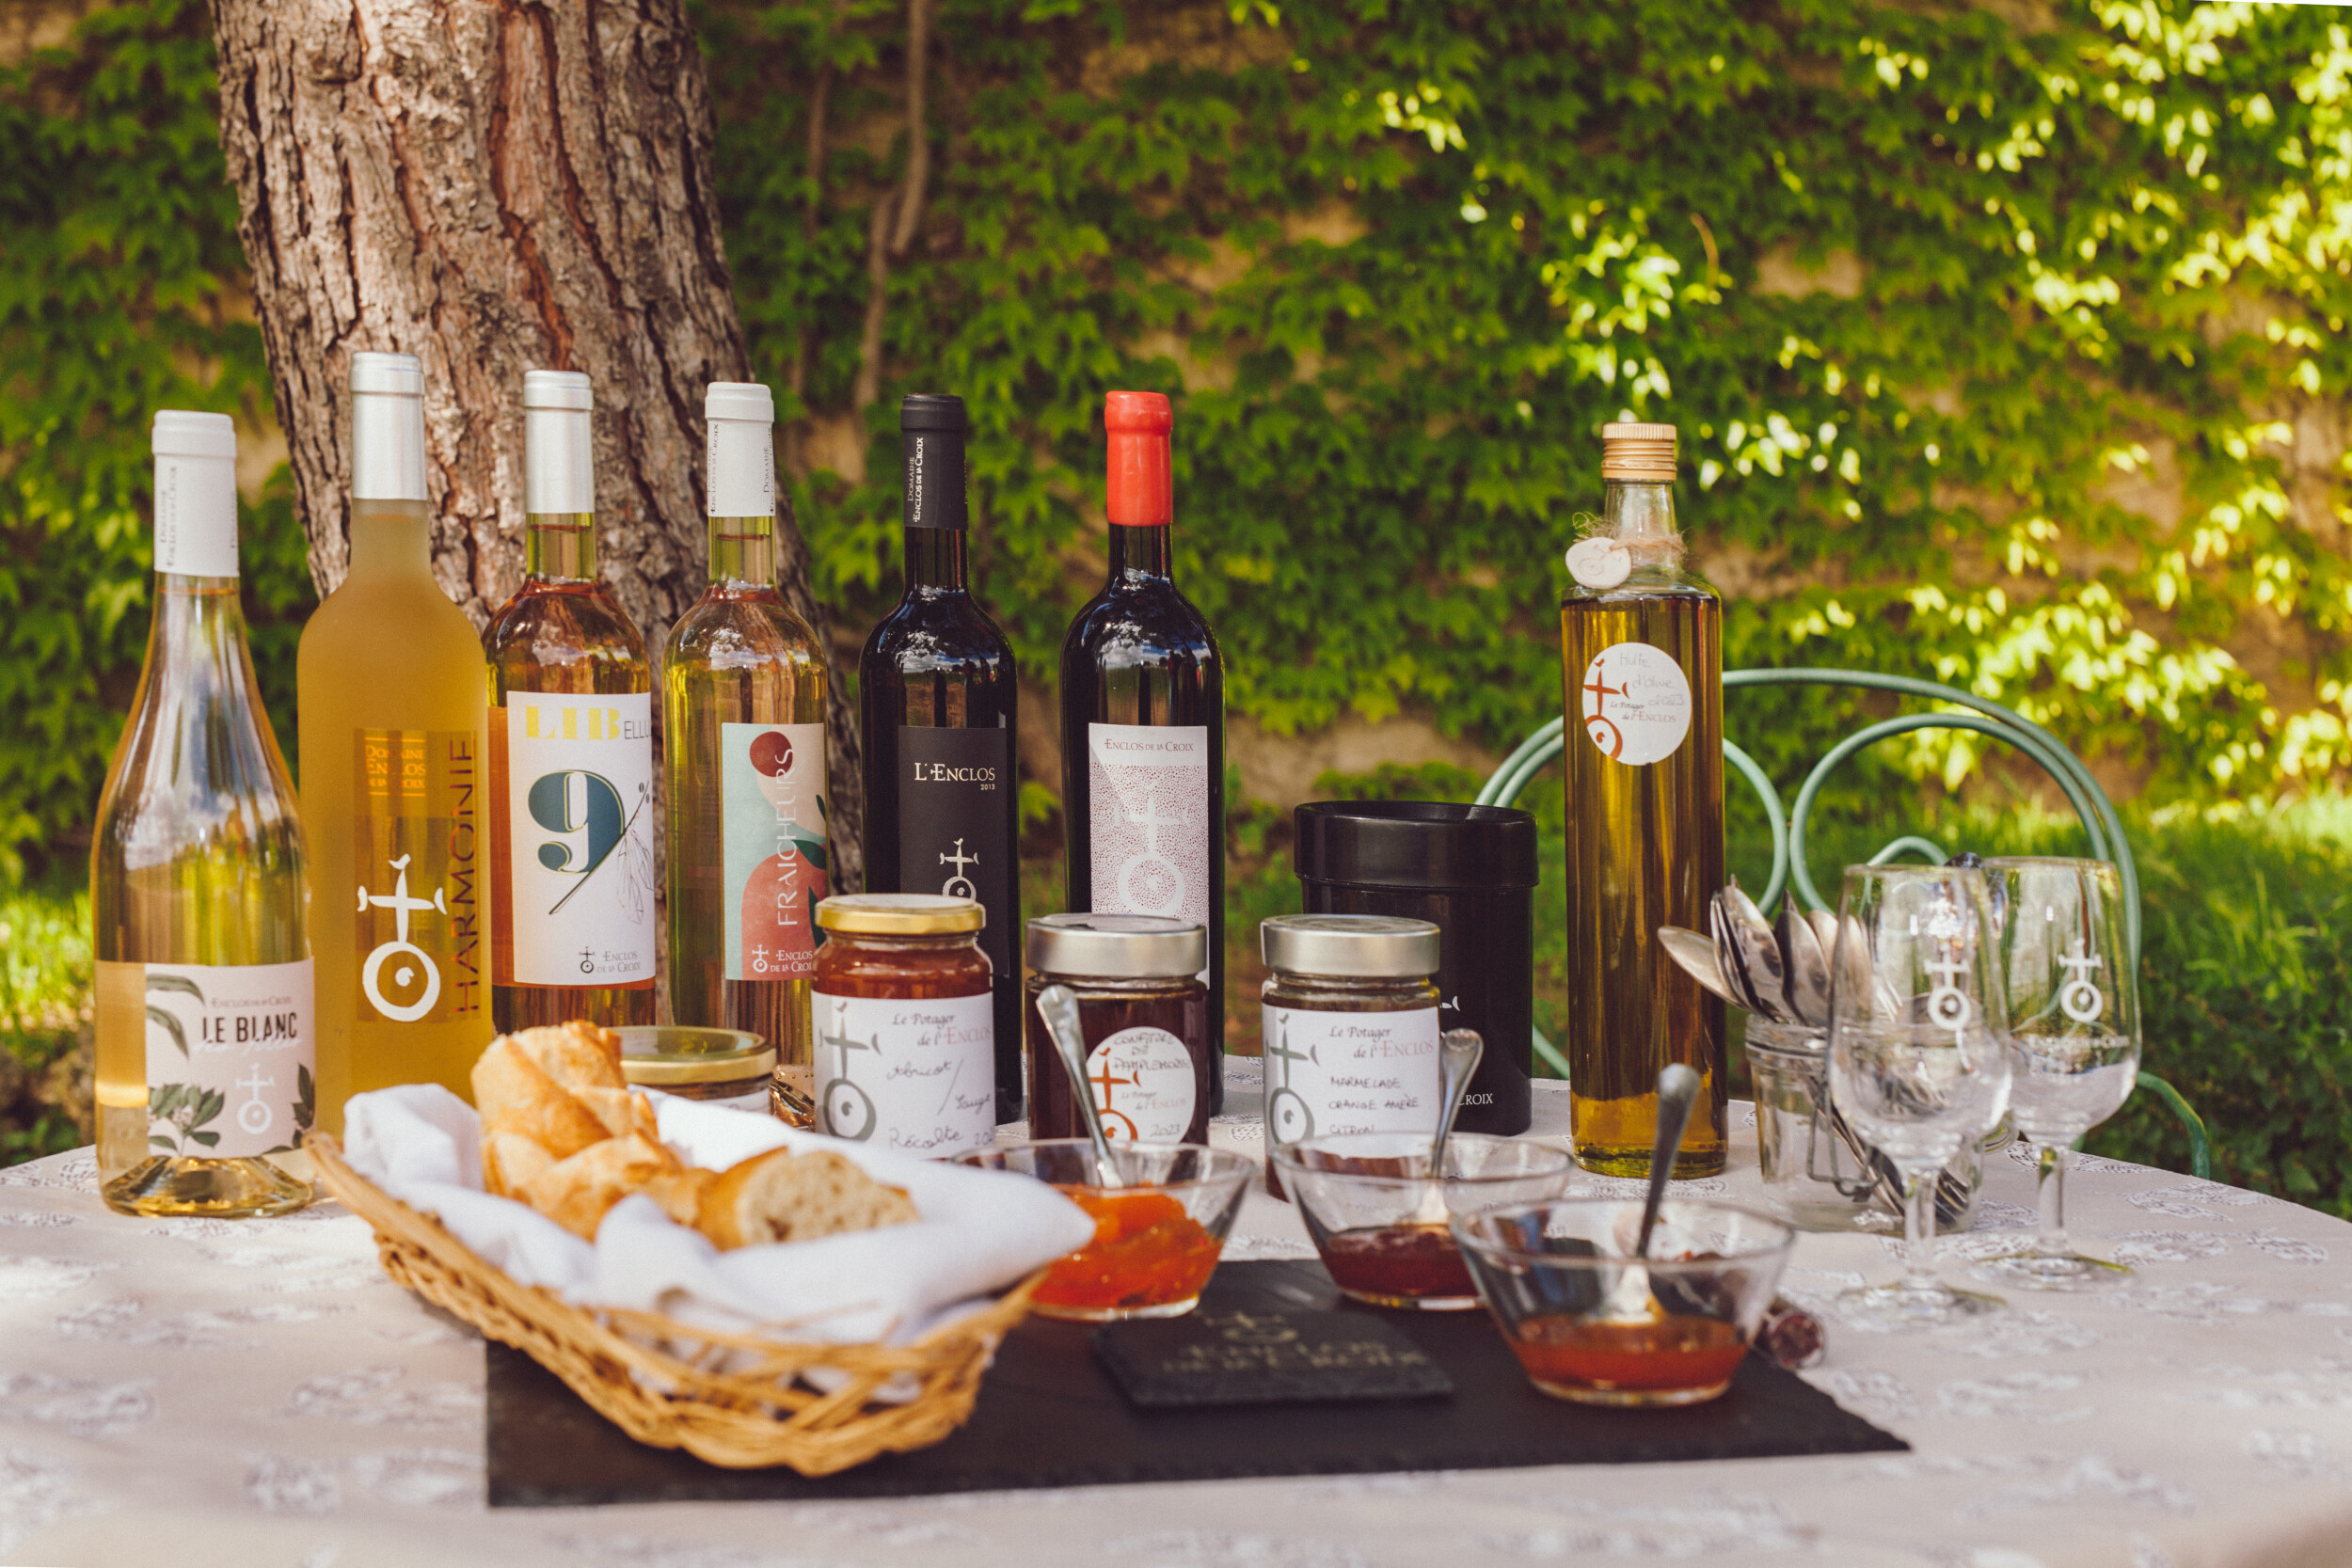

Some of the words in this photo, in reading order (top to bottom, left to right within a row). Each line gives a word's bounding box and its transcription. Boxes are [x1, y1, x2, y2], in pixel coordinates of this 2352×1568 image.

[914, 437, 923, 467] CROIX
[915, 474, 922, 484] DE
[913, 484, 922, 523] ENCLOS
[1104, 738, 1144, 752] ENCLOS
[1165, 741, 1194, 752] CROIX
[914, 762, 996, 782] L'ENCLOS
[449, 739, 479, 1013] HARMONIE
[603, 950, 638, 961] ENCLOS
[776, 949, 814, 961] ENCLOS
[617, 961, 642, 973] CROIX
[770, 964, 781, 973] DE
[782, 963, 789, 973] LA
[791, 960, 812, 973] CROI
[202, 1016, 226, 1044] LE
[235, 1011, 298, 1043] BLANC
[892, 1013, 908, 1026] Le
[911, 1012, 956, 1031] Potager
[916, 1032, 931, 1047] de
[1329, 1025, 1343, 1037] Le
[1346, 1025, 1392, 1043] Potager
[1352, 1043, 1367, 1058] de
[1329, 1076, 1402, 1089] MARMELADE
[1327, 1099, 1377, 1111] ORANGE
[1384, 1093, 1421, 1111] AMÈRE
